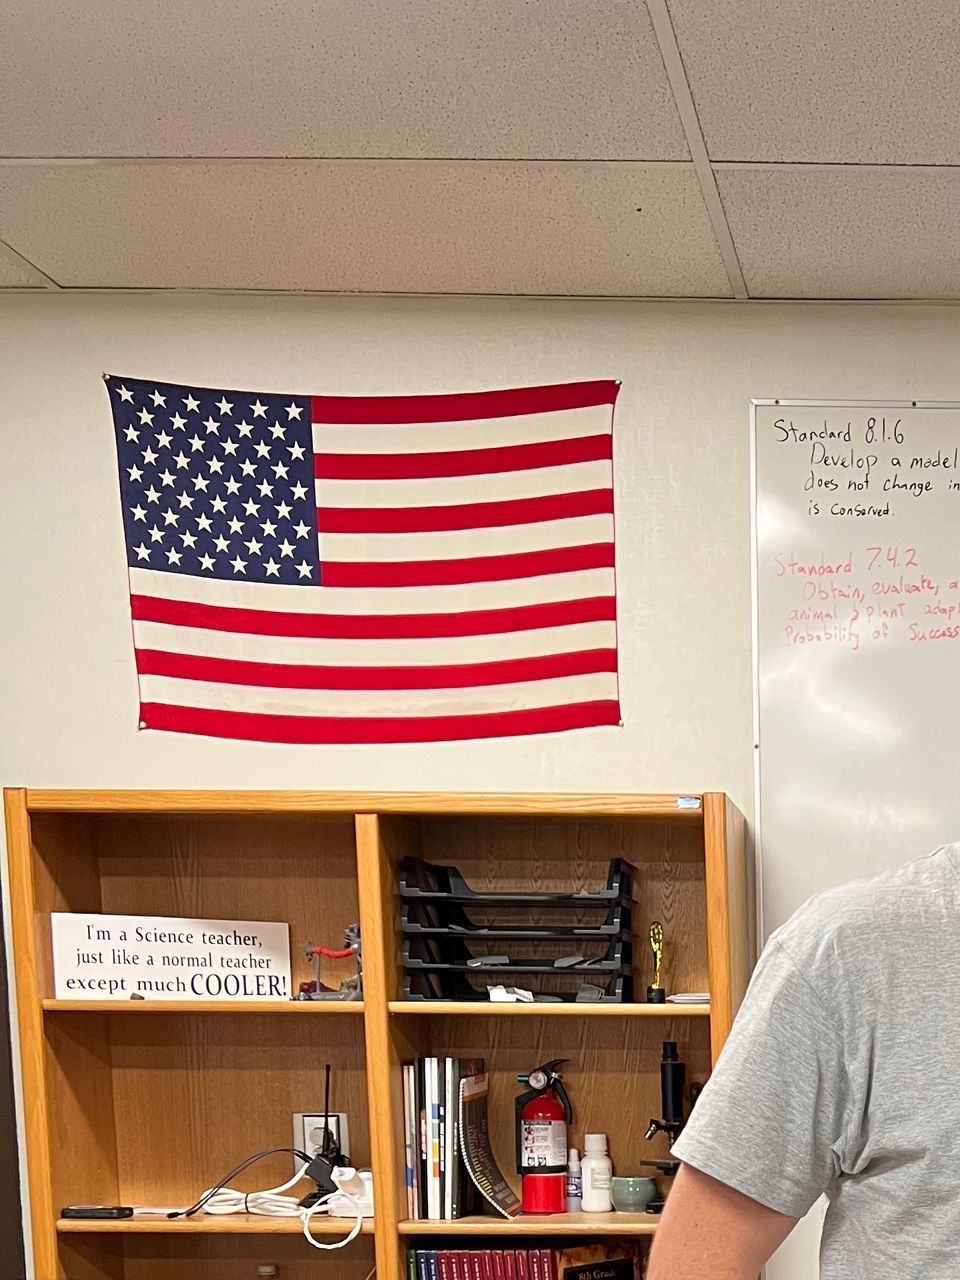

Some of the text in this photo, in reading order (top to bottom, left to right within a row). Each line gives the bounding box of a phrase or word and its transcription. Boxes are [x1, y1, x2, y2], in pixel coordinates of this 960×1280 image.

[774, 417, 904, 444] Standard 8.1.6
[810, 442, 878, 474] Develop
[891, 456, 902, 468] a
[910, 448, 958, 469] model
[803, 471, 839, 491] does
[849, 473, 870, 491] not
[883, 477, 933, 499] change
[949, 479, 960, 491] in
[808, 499, 820, 516] is
[774, 547, 918, 577] Standard 7.4.2
[802, 580, 865, 602] Obtain,
[872, 574, 939, 596] evaluate,
[788, 606, 837, 622] animal
[873, 621, 889, 640] of
[87, 924, 263, 948] I'm a Science teacher,
[76, 949, 272, 969] just like a normal teacher
[66, 973, 288, 998] except much COOLER!
